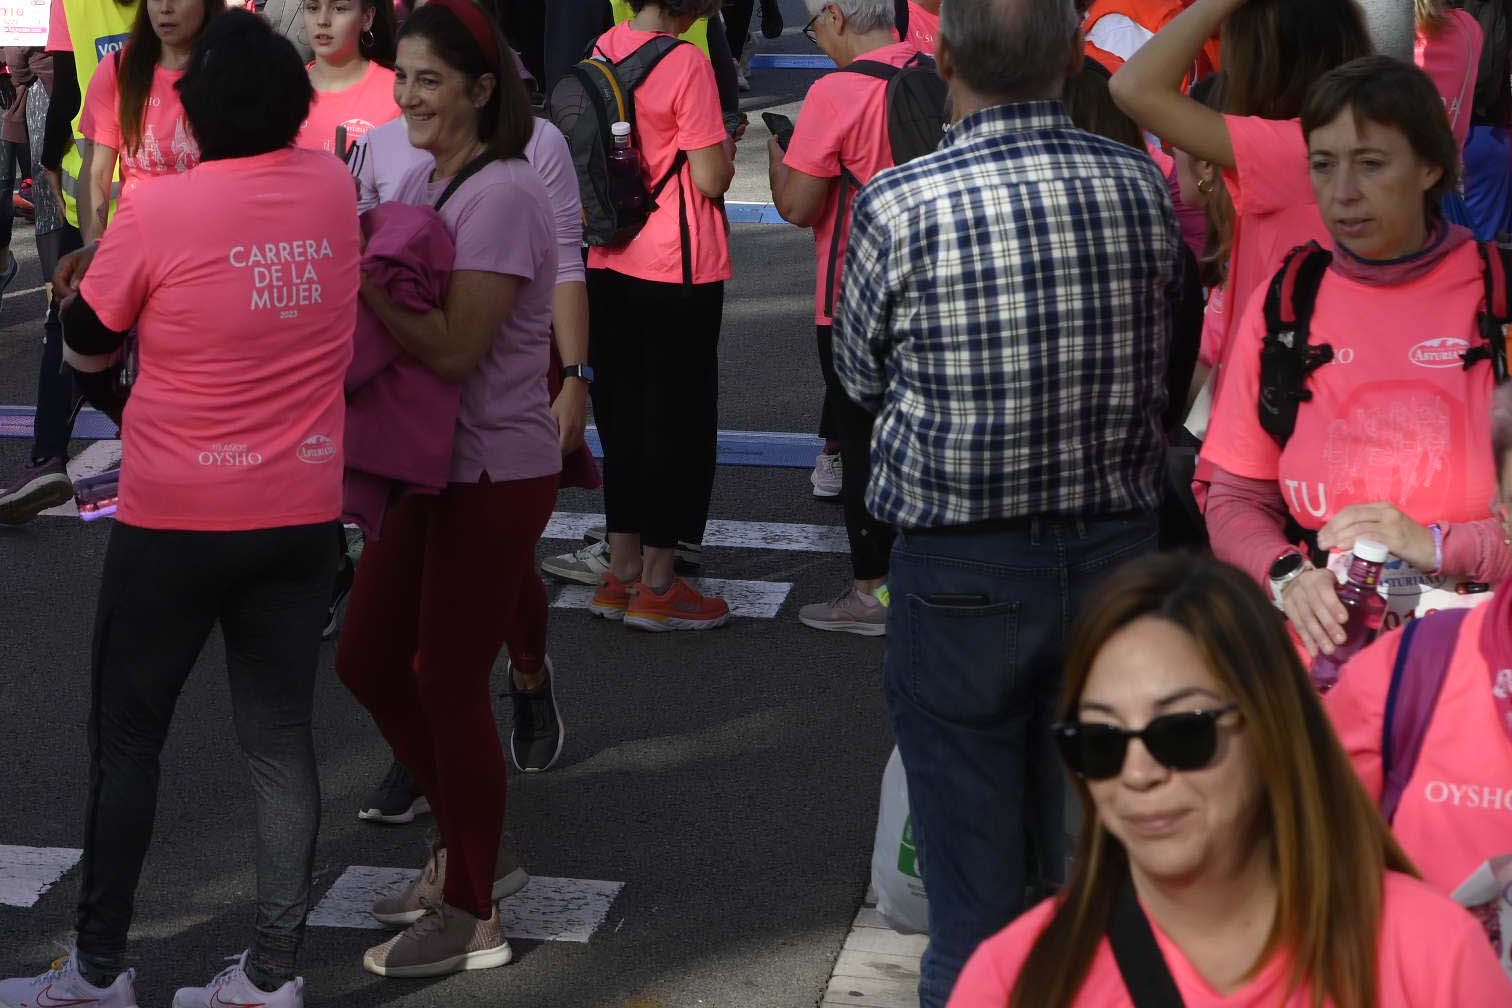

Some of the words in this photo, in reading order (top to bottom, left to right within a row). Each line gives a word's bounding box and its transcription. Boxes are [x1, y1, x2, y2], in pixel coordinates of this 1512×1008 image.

[230, 238, 333, 268] CARRERA
[253, 267, 283, 289] DE
[292, 263, 318, 284] LA
[250, 284, 324, 311] MUJER
[198, 451, 263, 466] OYSHO
[1285, 479, 1328, 518] TU
